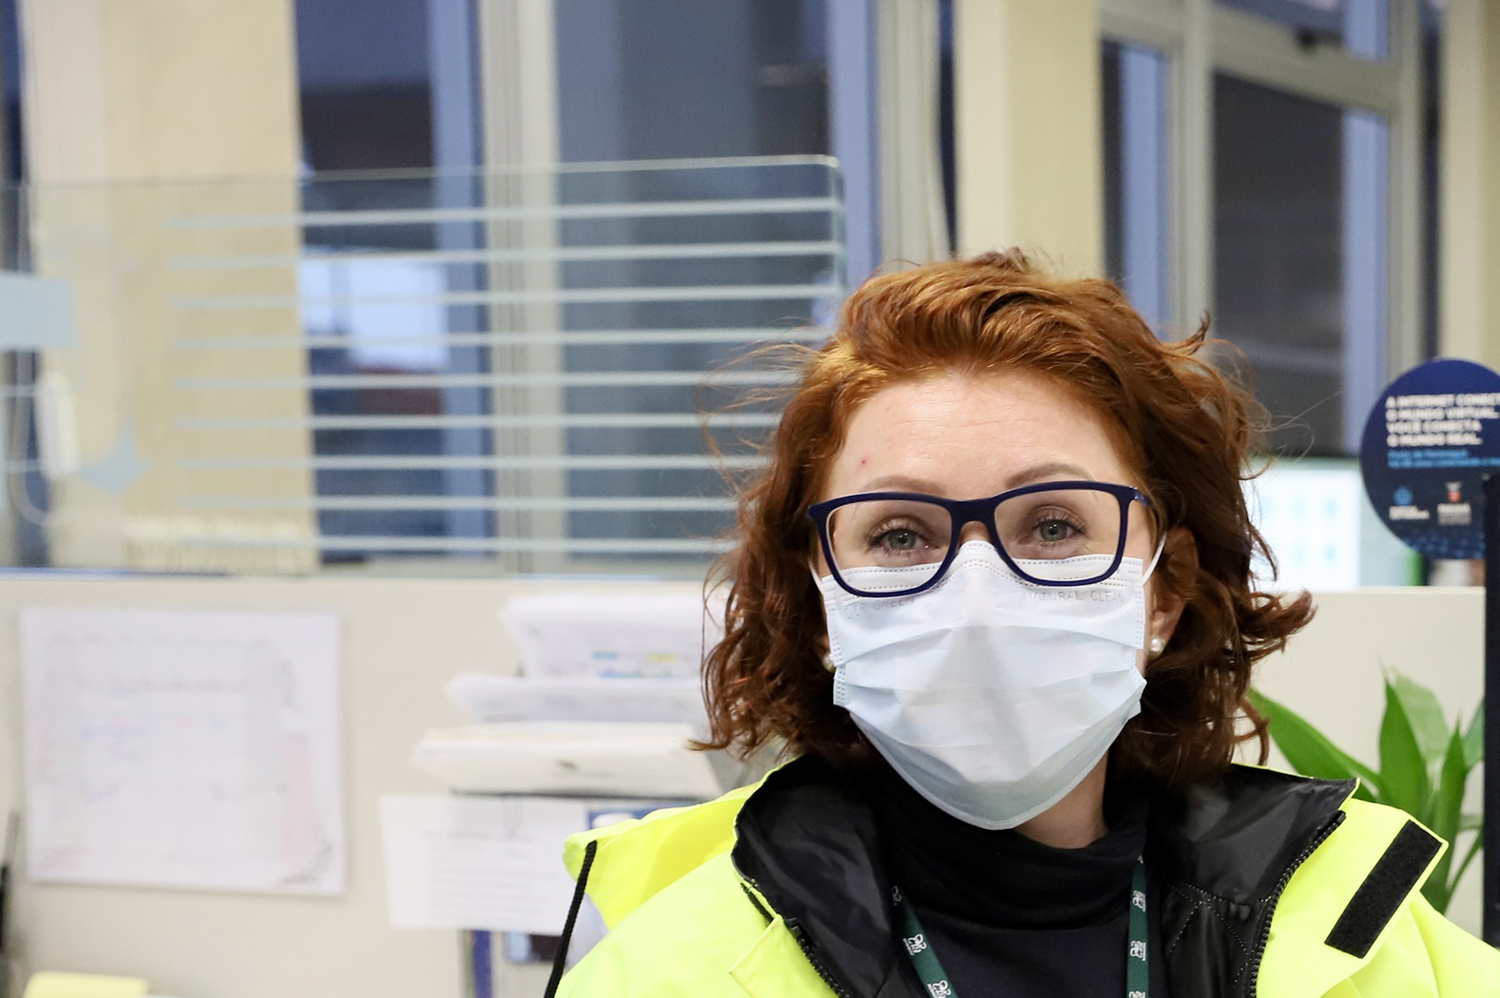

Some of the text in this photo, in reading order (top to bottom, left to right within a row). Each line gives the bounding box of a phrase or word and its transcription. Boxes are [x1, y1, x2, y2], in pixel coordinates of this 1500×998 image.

[1385, 396, 1396, 408] A
[1397, 394, 1454, 408] INTERNET
[1398, 407, 1444, 420] MUNDO
[1386, 419, 1482, 433] VOCÊ CONECTA
[1399, 433, 1445, 446] MUNDO
